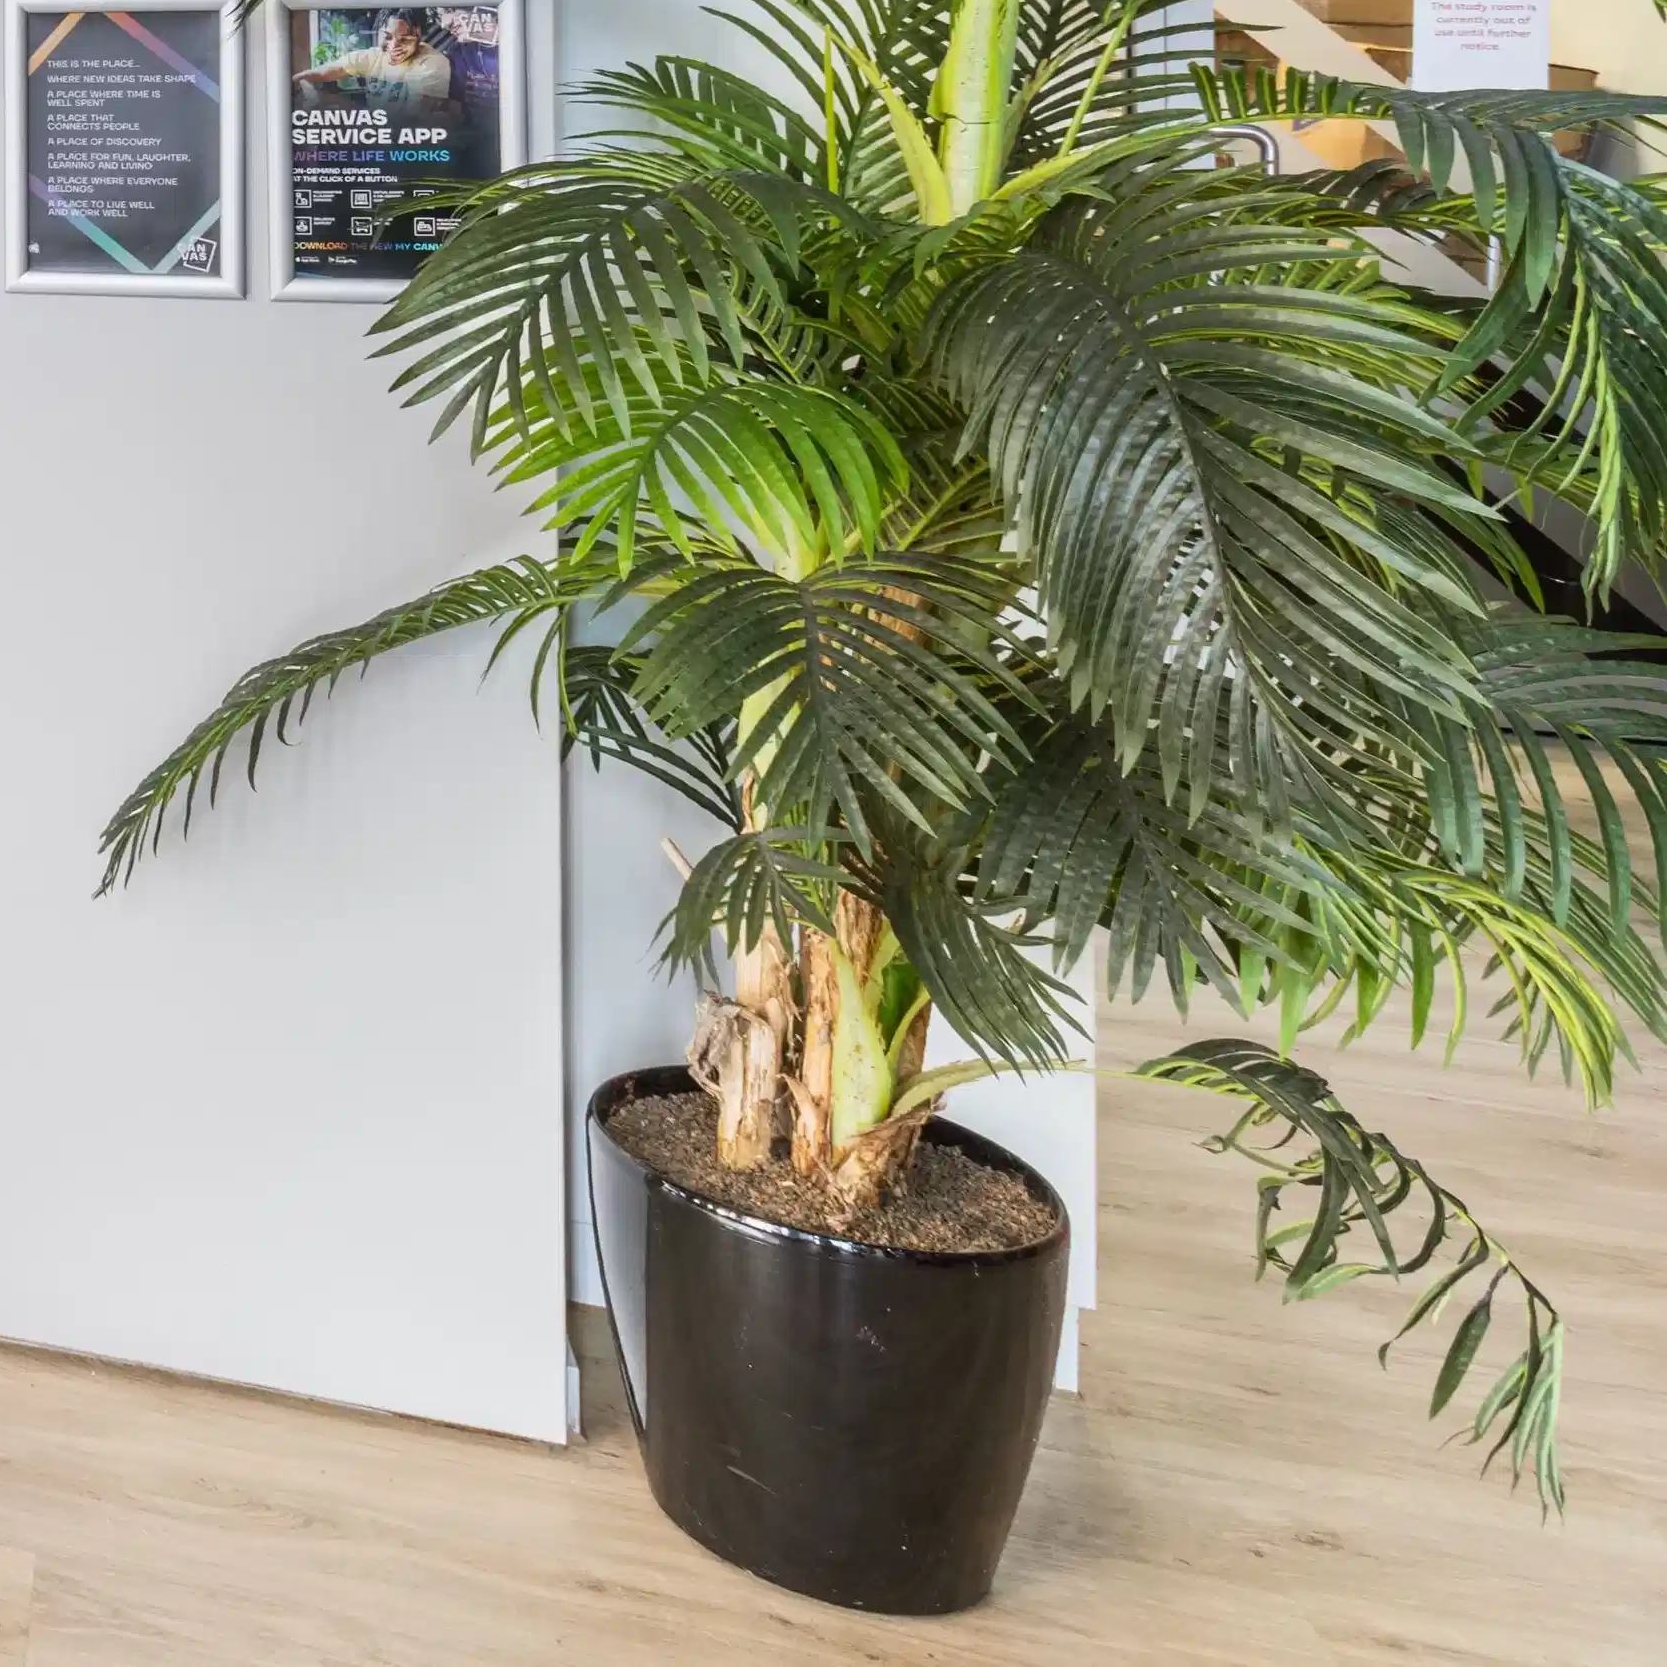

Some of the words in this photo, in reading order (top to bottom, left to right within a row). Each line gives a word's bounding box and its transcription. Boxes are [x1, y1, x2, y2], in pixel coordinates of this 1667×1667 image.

[1431, 2, 1451, 11] The
[1455, 2, 1487, 12] study
[1491, 4, 1524, 12] room
[1527, 2, 1536, 12] is
[459, 14, 492, 23] CAN
[1436, 16, 1488, 26] currently
[1494, 16, 1514, 25] out
[1517, 16, 1531, 24] of
[1434, 29, 1453, 37] use
[1457, 28, 1483, 38] until
[1487, 28, 1531, 38] further
[47, 60, 67, 68] THIS
[70, 60, 79, 68] IS
[82, 60, 99, 68] THE
[47, 75, 80, 83] WHERE
[83, 75, 104, 83] NEW
[107, 75, 135, 83] IDEAS
[138, 75, 161, 83] TAKE
[164, 75, 196, 83] SHAPE
[47, 114, 54, 122] A
[56, 114, 87, 122] PLACE
[90, 114, 114, 122] THAT
[292, 109, 388, 126] CANVAS
[292, 128, 392, 144] SERVICE
[398, 128, 447, 144] APP
[56, 138, 87, 146] PLACE
[90, 138, 102, 146] OF
[106, 138, 162, 146] DISCOVERY
[56, 153, 87, 161] PLACE
[90, 153, 109, 161] FOR
[136, 154, 191, 162] LAUGHTER,
[294, 150, 347, 161] WHERE
[352, 150, 384, 161] LIFE
[389, 150, 450, 162] WORKS
[98, 162, 118, 170] AND
[120, 162, 153, 170] LIVING
[90, 177, 123, 185] WHERE
[127, 177, 178, 185] EVERYONE
[48, 185, 94, 193] BELONGS
[48, 200, 54, 208] A
[57, 200, 88, 208] PLACE
[129, 201, 155, 209] WELL
[70, 209, 99, 217] WORK
[102, 209, 127, 217] WELL
[177, 243, 206, 253] CAN
[395, 242, 410, 251] MY
[181, 252, 208, 261] VAS
